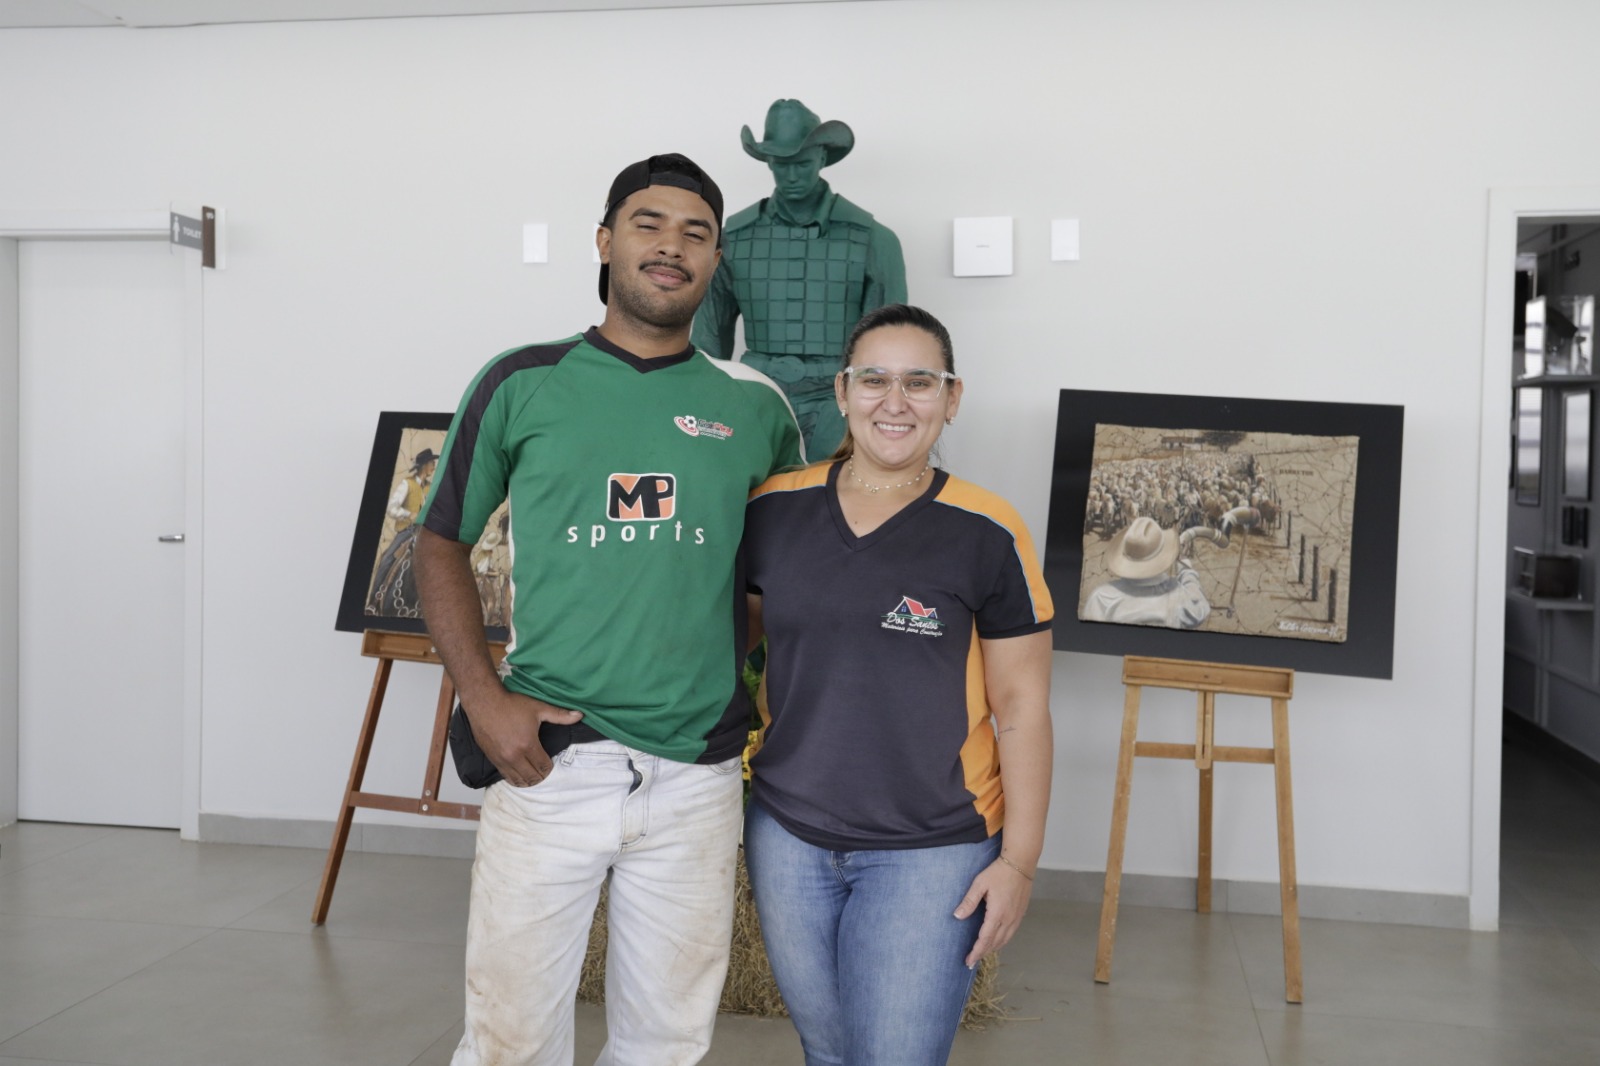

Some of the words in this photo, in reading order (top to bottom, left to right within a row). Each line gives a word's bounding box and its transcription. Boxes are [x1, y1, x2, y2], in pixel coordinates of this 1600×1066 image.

[607, 473, 675, 520] MP
[567, 520, 704, 548] sports
[886, 612, 905, 625] Dos
[909, 616, 939, 630] Santos
